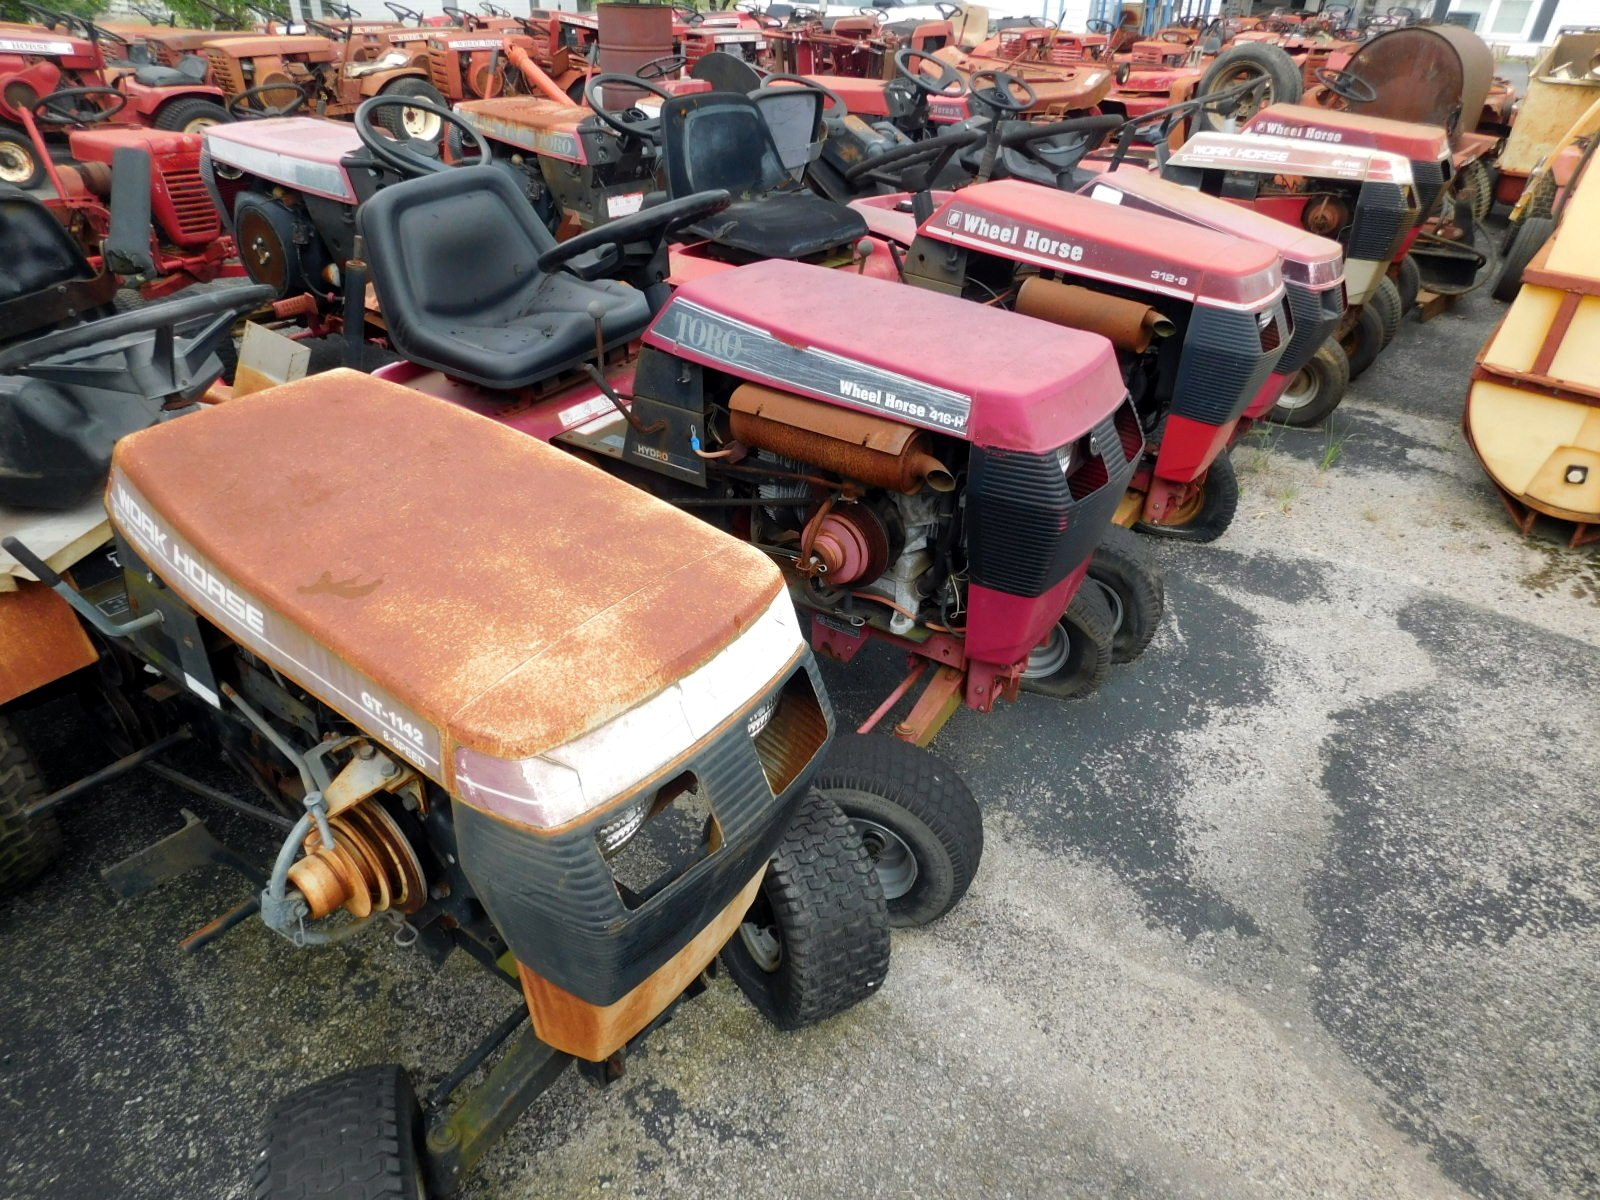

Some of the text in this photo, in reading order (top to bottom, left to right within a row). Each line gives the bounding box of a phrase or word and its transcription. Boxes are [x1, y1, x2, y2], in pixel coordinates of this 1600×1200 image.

[1193, 145, 1290, 162] WORK HORSE
[1266, 123, 1342, 142] Wheel Horse
[964, 213, 1083, 262] Wheel Horse
[1150, 270, 1188, 286] 312-8
[674, 311, 744, 361] TORO
[839, 379, 965, 428] Wheel Horse 416-H
[637, 444, 669, 462] HYDRO
[117, 482, 168, 557] WORK
[174, 543, 264, 635] HORSE
[361, 691, 424, 748] GT-1142
